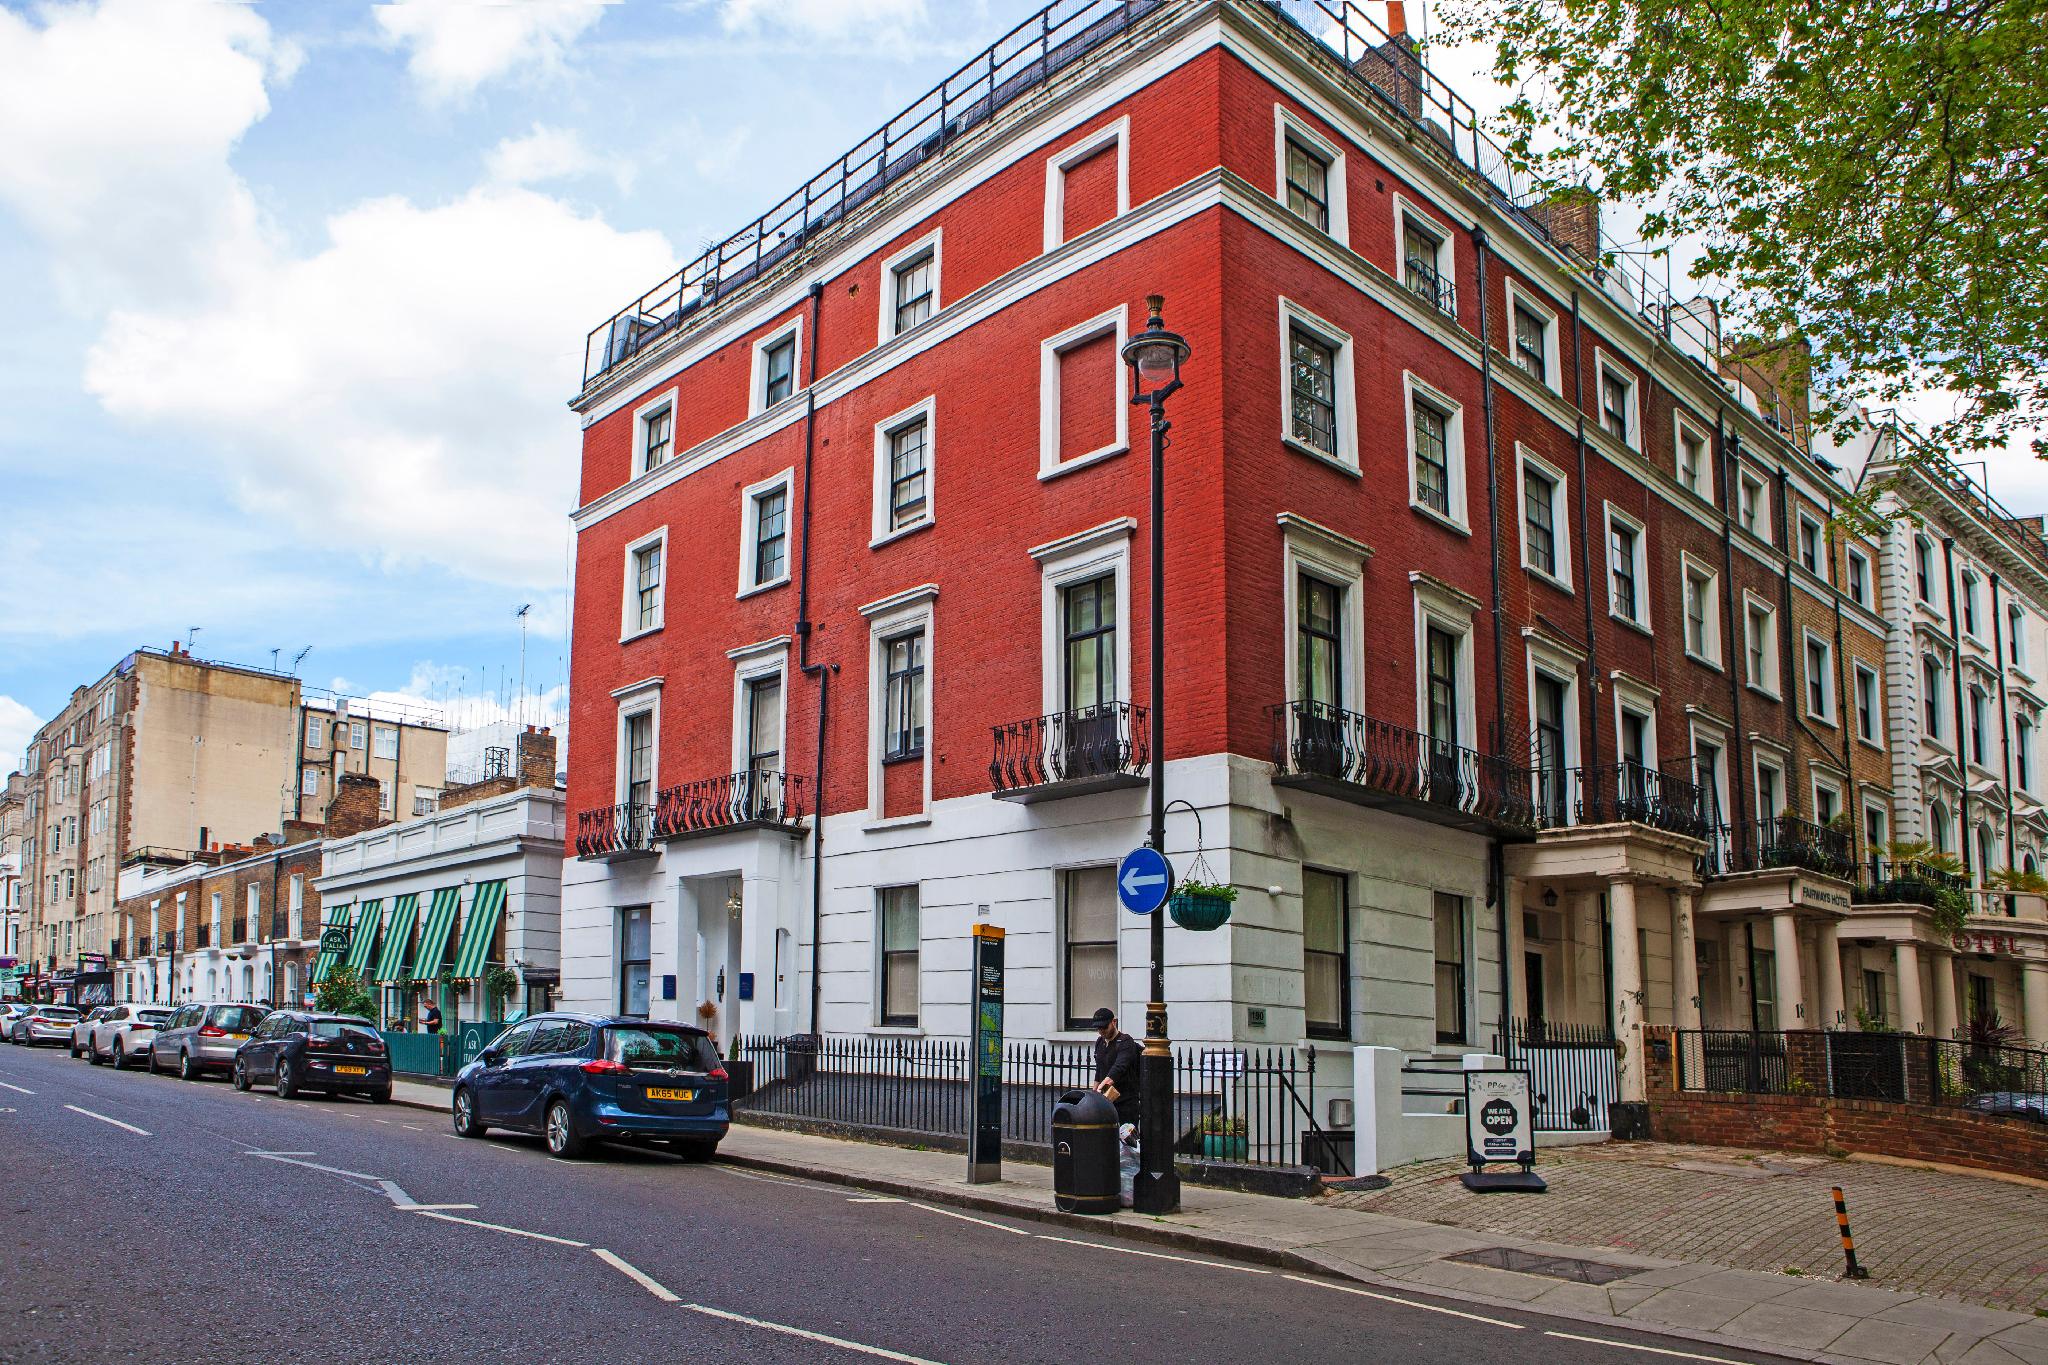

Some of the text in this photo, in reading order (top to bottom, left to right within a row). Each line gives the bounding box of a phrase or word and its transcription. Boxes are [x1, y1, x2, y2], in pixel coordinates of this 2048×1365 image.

[1803, 886, 1850, 908] FAIRWAYS HOTEL
[322, 941, 348, 949] ITALIAN
[1951, 932, 2022, 954] OTEL
[468, 1040, 477, 1050] ASK
[651, 1089, 689, 1099] AK65 WUC
[1486, 1115, 1513, 1125] OPEN
